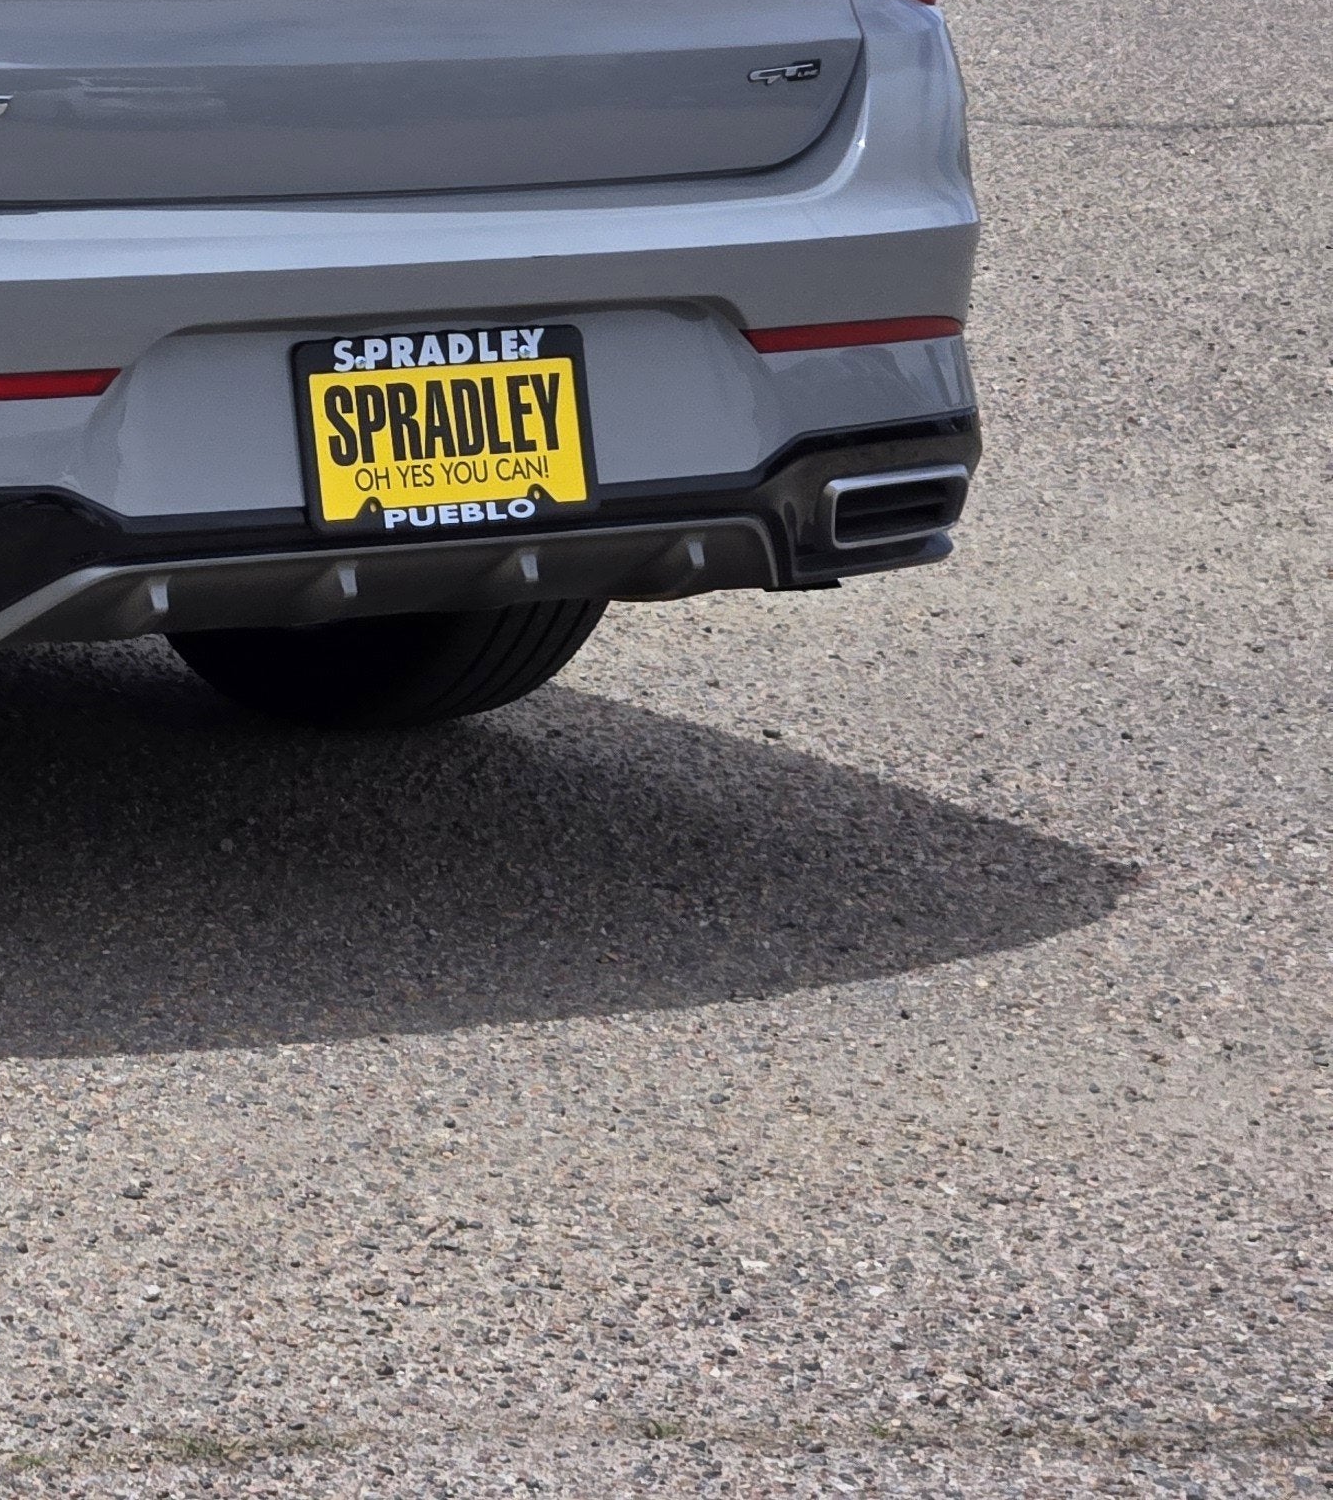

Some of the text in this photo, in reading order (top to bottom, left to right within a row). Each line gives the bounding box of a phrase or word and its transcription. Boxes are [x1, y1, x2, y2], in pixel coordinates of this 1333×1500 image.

[333, 327, 545, 372] SPRADLEY
[323, 372, 561, 467] SPRADLEY
[354, 455, 549, 492] OH YES YOU CAN!
[383, 499, 535, 530] PUEBLO
